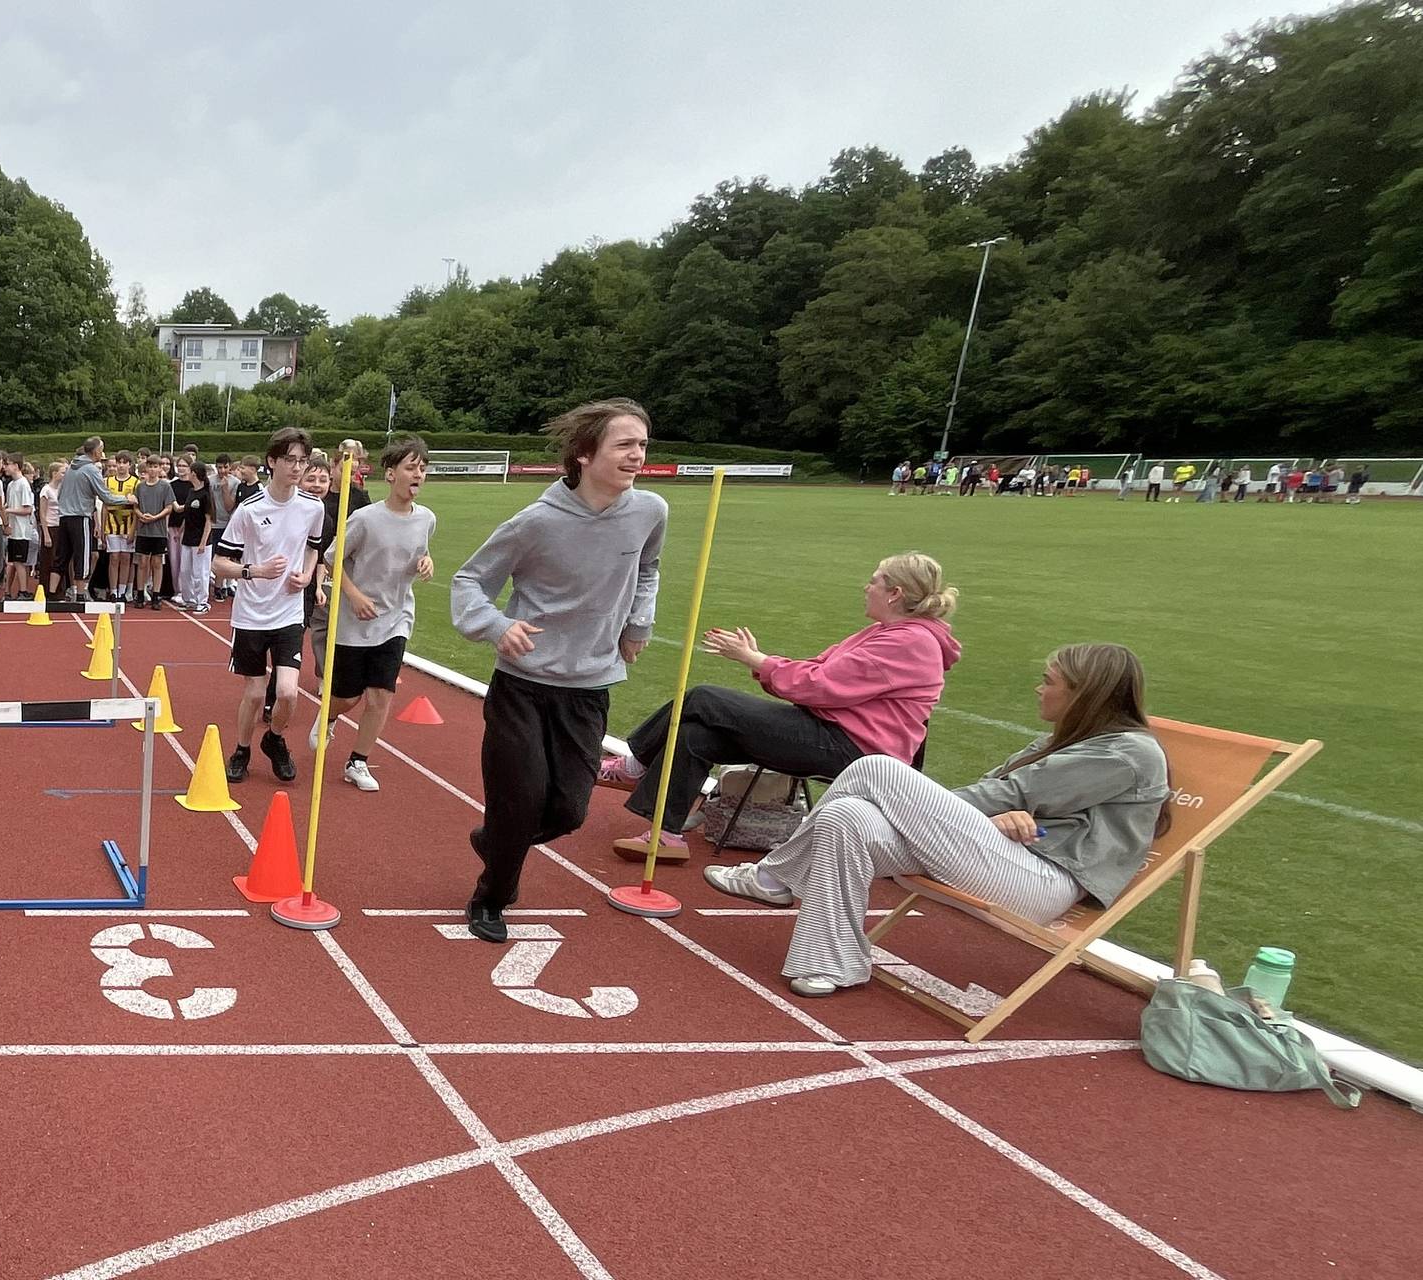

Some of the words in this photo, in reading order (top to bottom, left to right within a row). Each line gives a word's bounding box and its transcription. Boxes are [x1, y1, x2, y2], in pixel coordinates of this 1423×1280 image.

[1168, 787, 1204, 809] den
[90, 922, 238, 1020] 3
[432, 923, 640, 1019] 2
